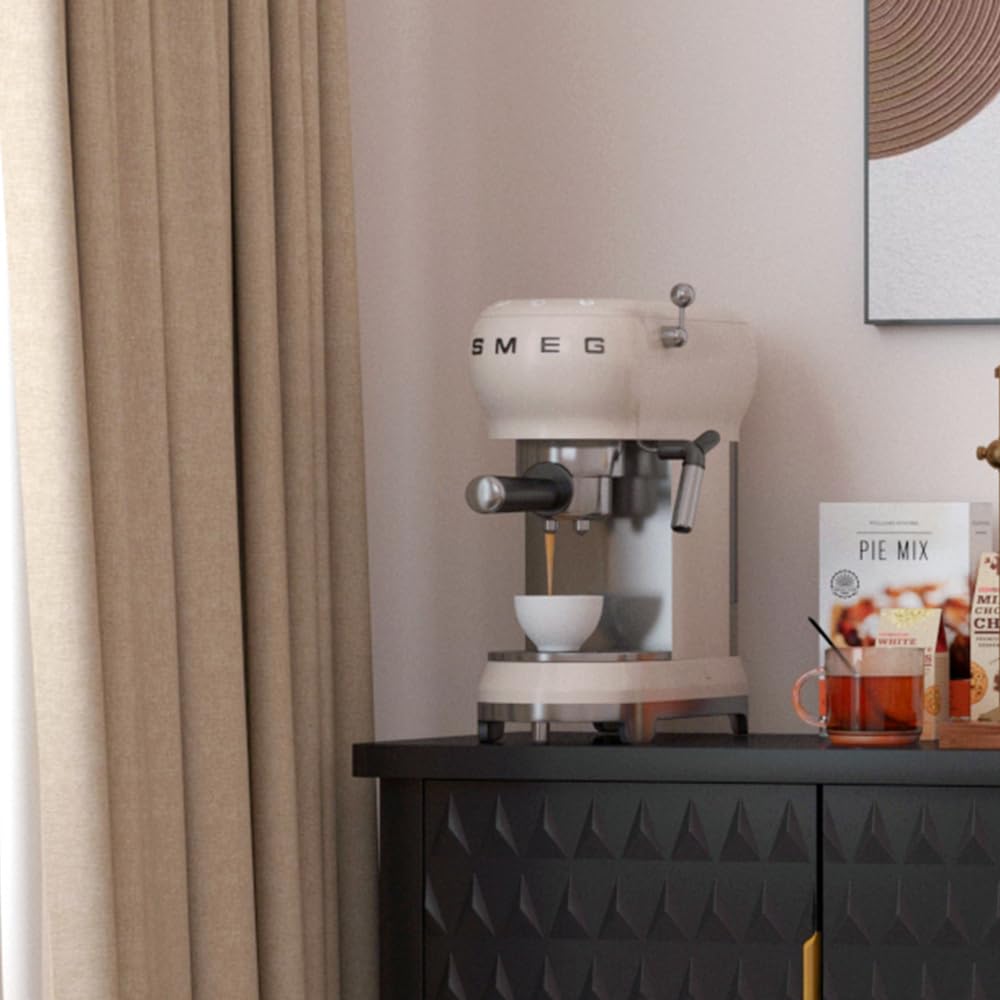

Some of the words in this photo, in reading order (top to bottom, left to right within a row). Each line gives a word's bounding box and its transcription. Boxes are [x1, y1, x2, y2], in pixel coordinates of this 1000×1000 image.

[471, 337, 605, 355] SMEG
[859, 540, 887, 561] PIE
[897, 540, 929, 561] MIX
[878, 637, 917, 646] WHITE
